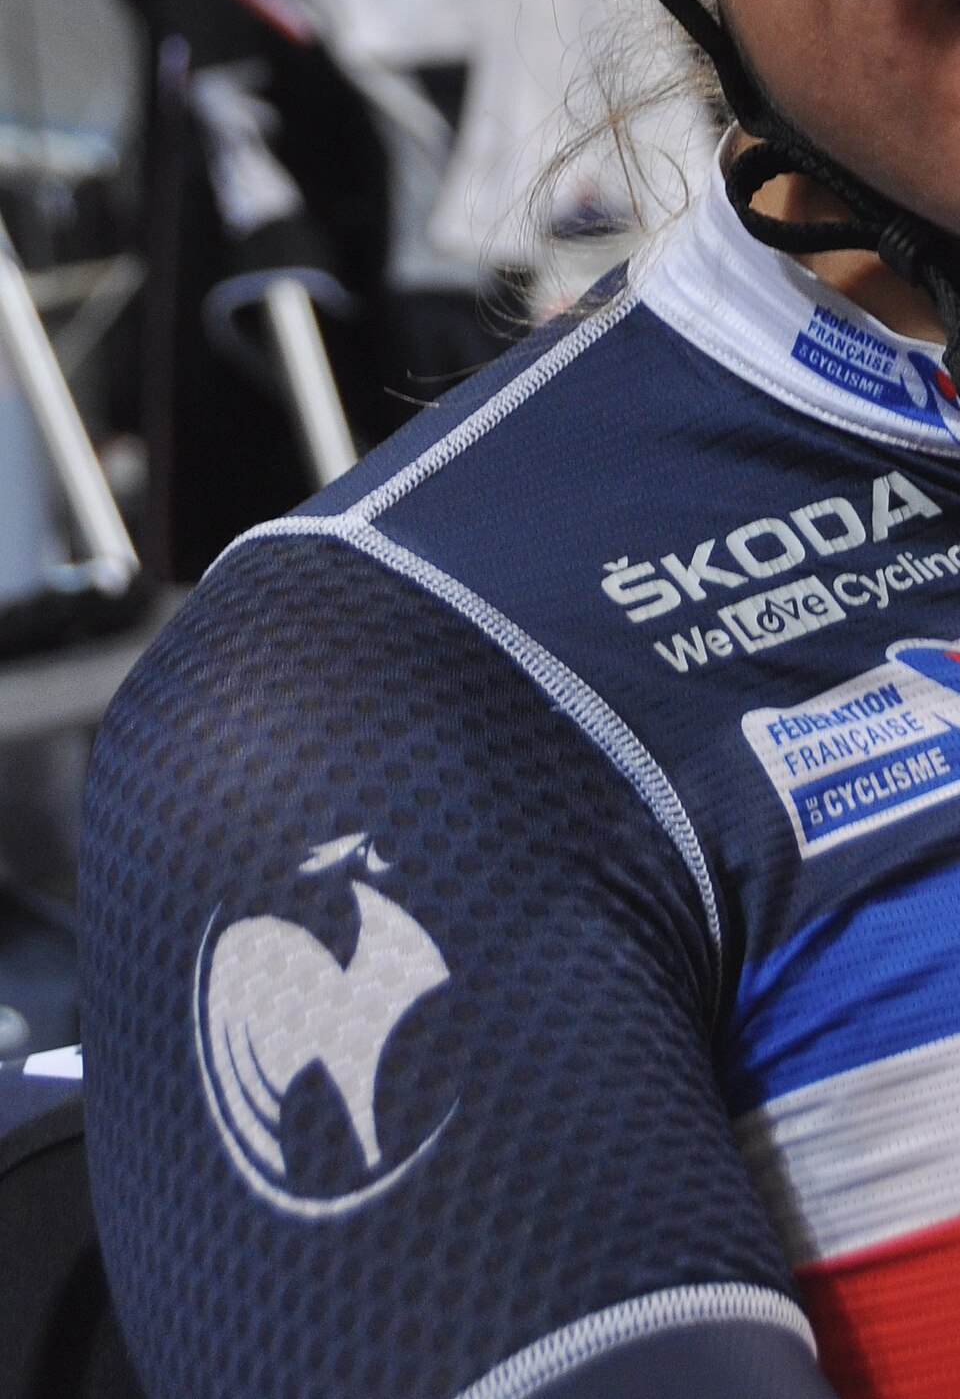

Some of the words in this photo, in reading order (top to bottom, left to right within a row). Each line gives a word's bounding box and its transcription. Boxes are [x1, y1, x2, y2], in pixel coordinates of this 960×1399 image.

[809, 348, 884, 396] CYCLISME
[601, 470, 943, 623] ŠKODA
[766, 682, 904, 746] FÉDÉRATION
[784, 711, 925, 778] FRANÇAISE
[822, 746, 951, 819] CYCLISME
